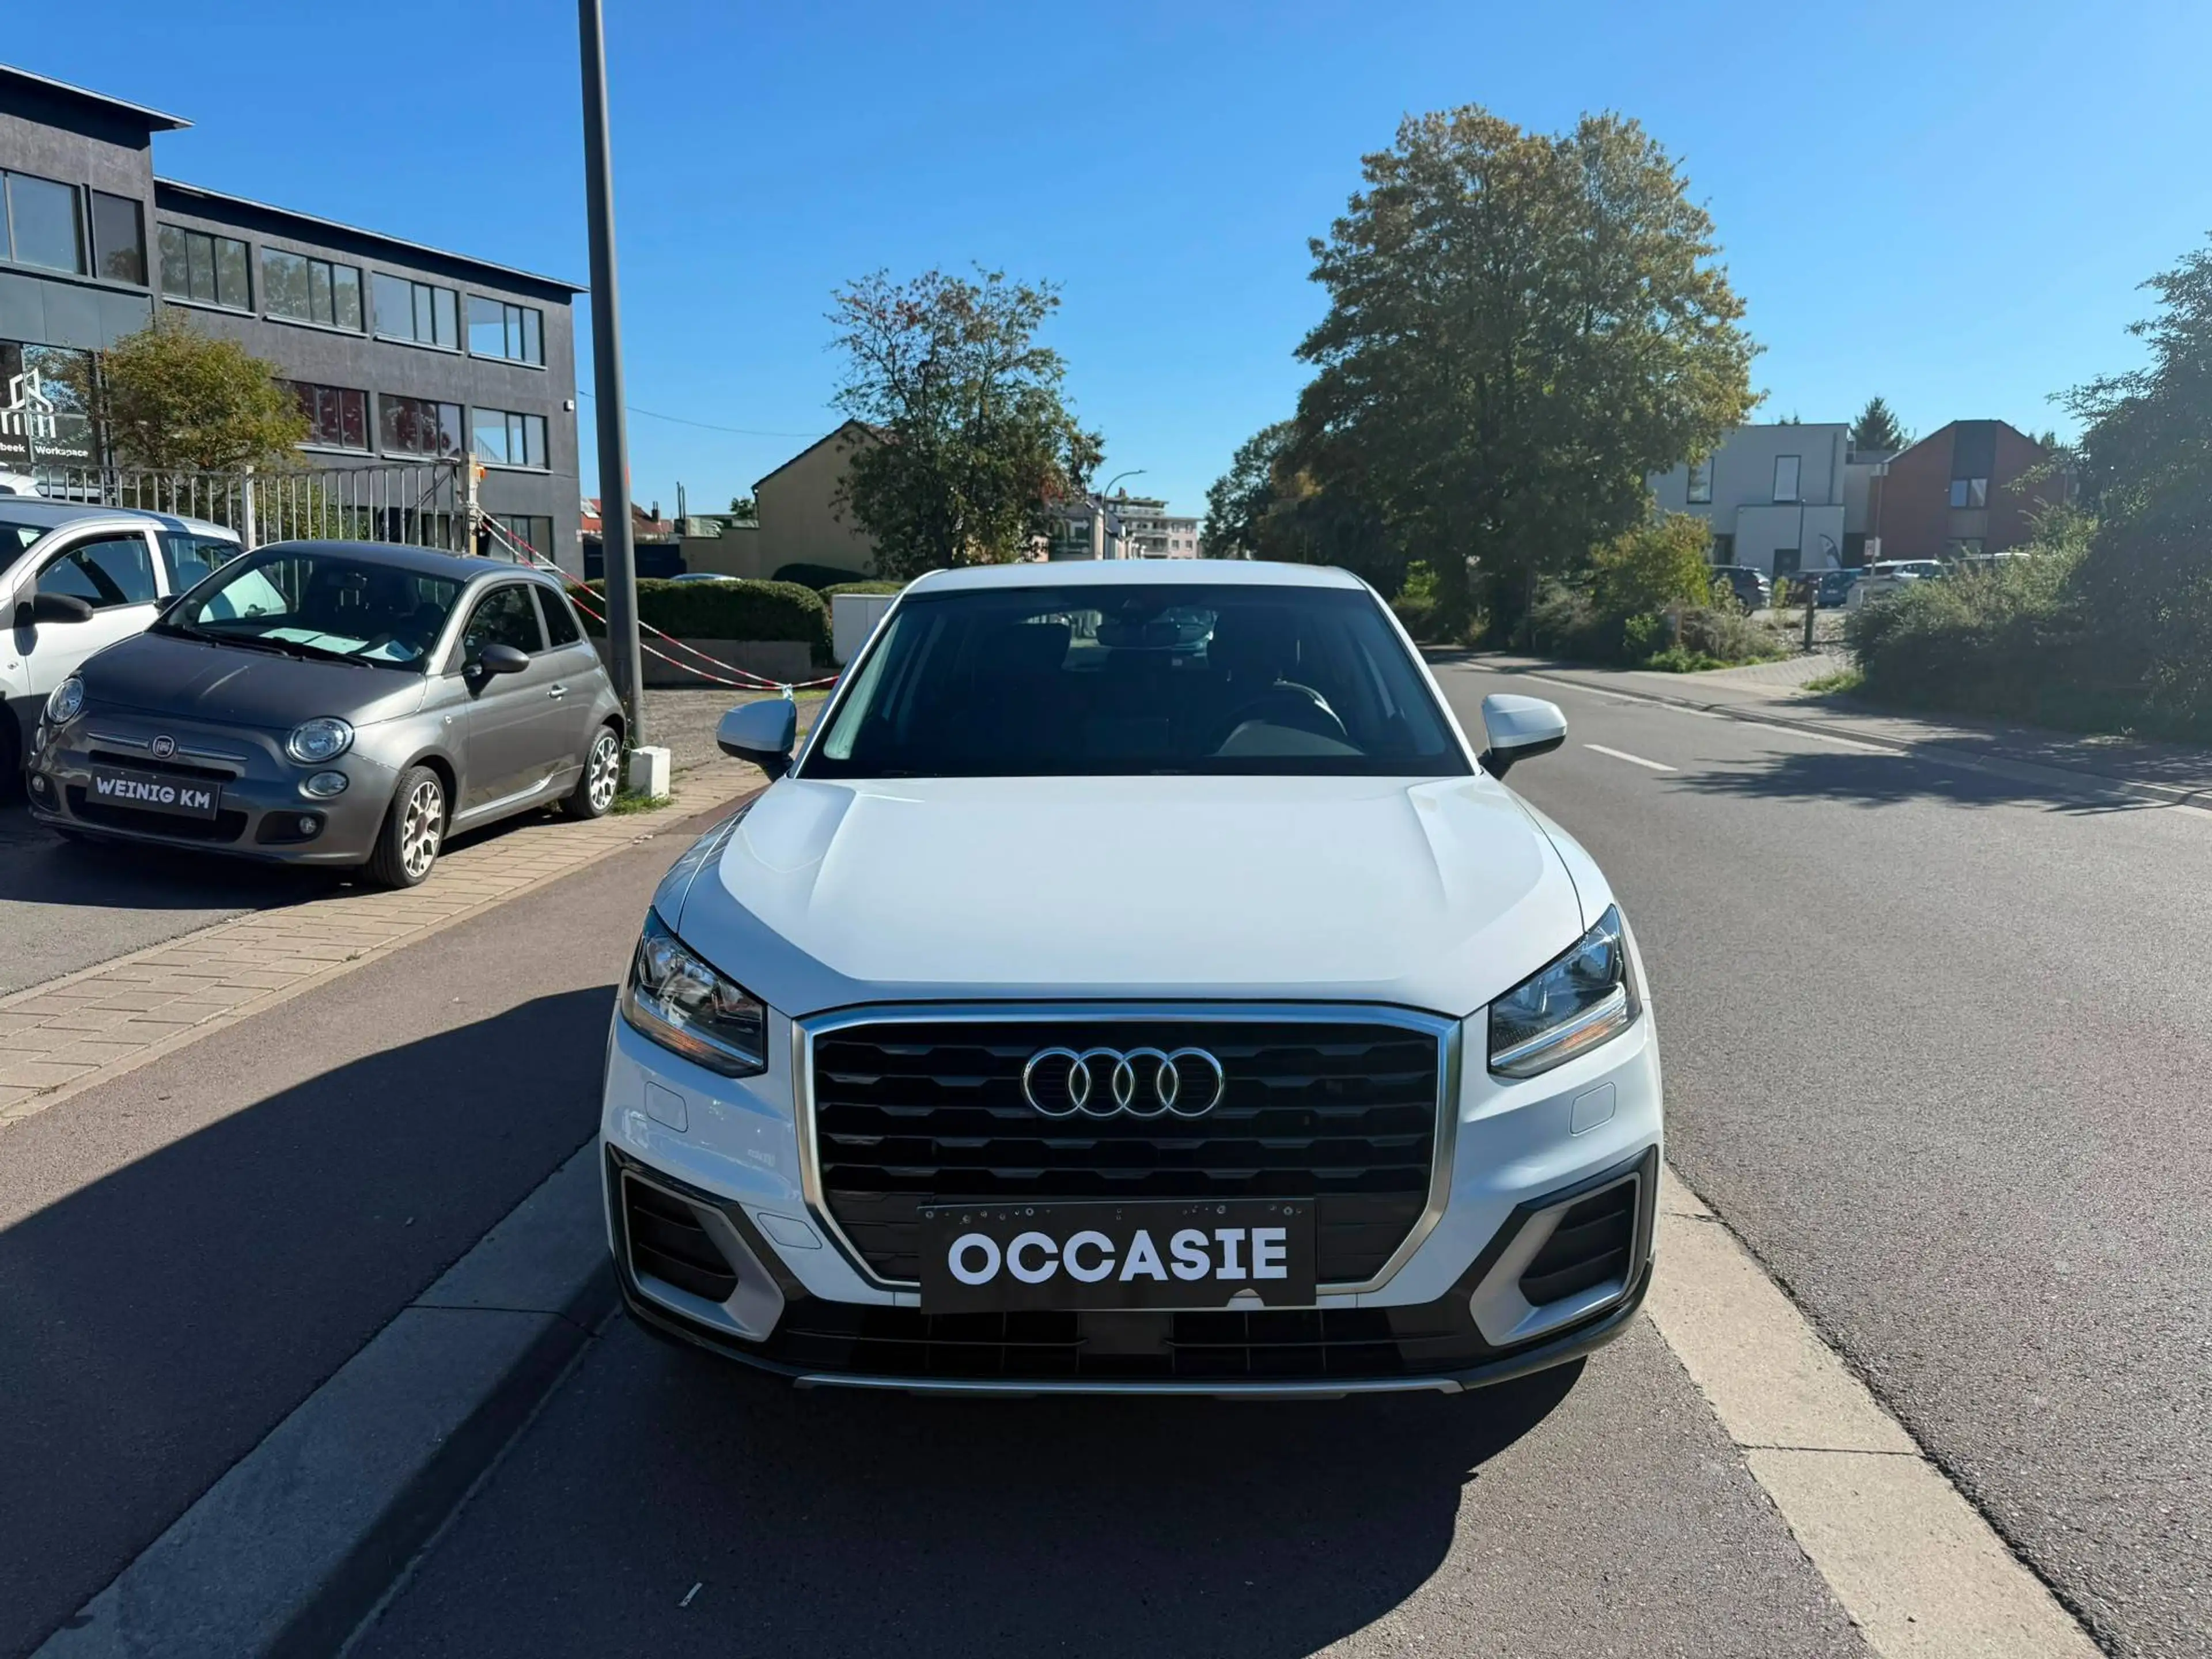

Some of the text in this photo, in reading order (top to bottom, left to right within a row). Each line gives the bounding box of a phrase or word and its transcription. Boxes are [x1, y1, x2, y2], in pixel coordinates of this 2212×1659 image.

[156, 740, 171, 752] FIAT
[96, 777, 210, 809] WEINIG KM
[948, 1228, 1287, 1285] OCCASIE
